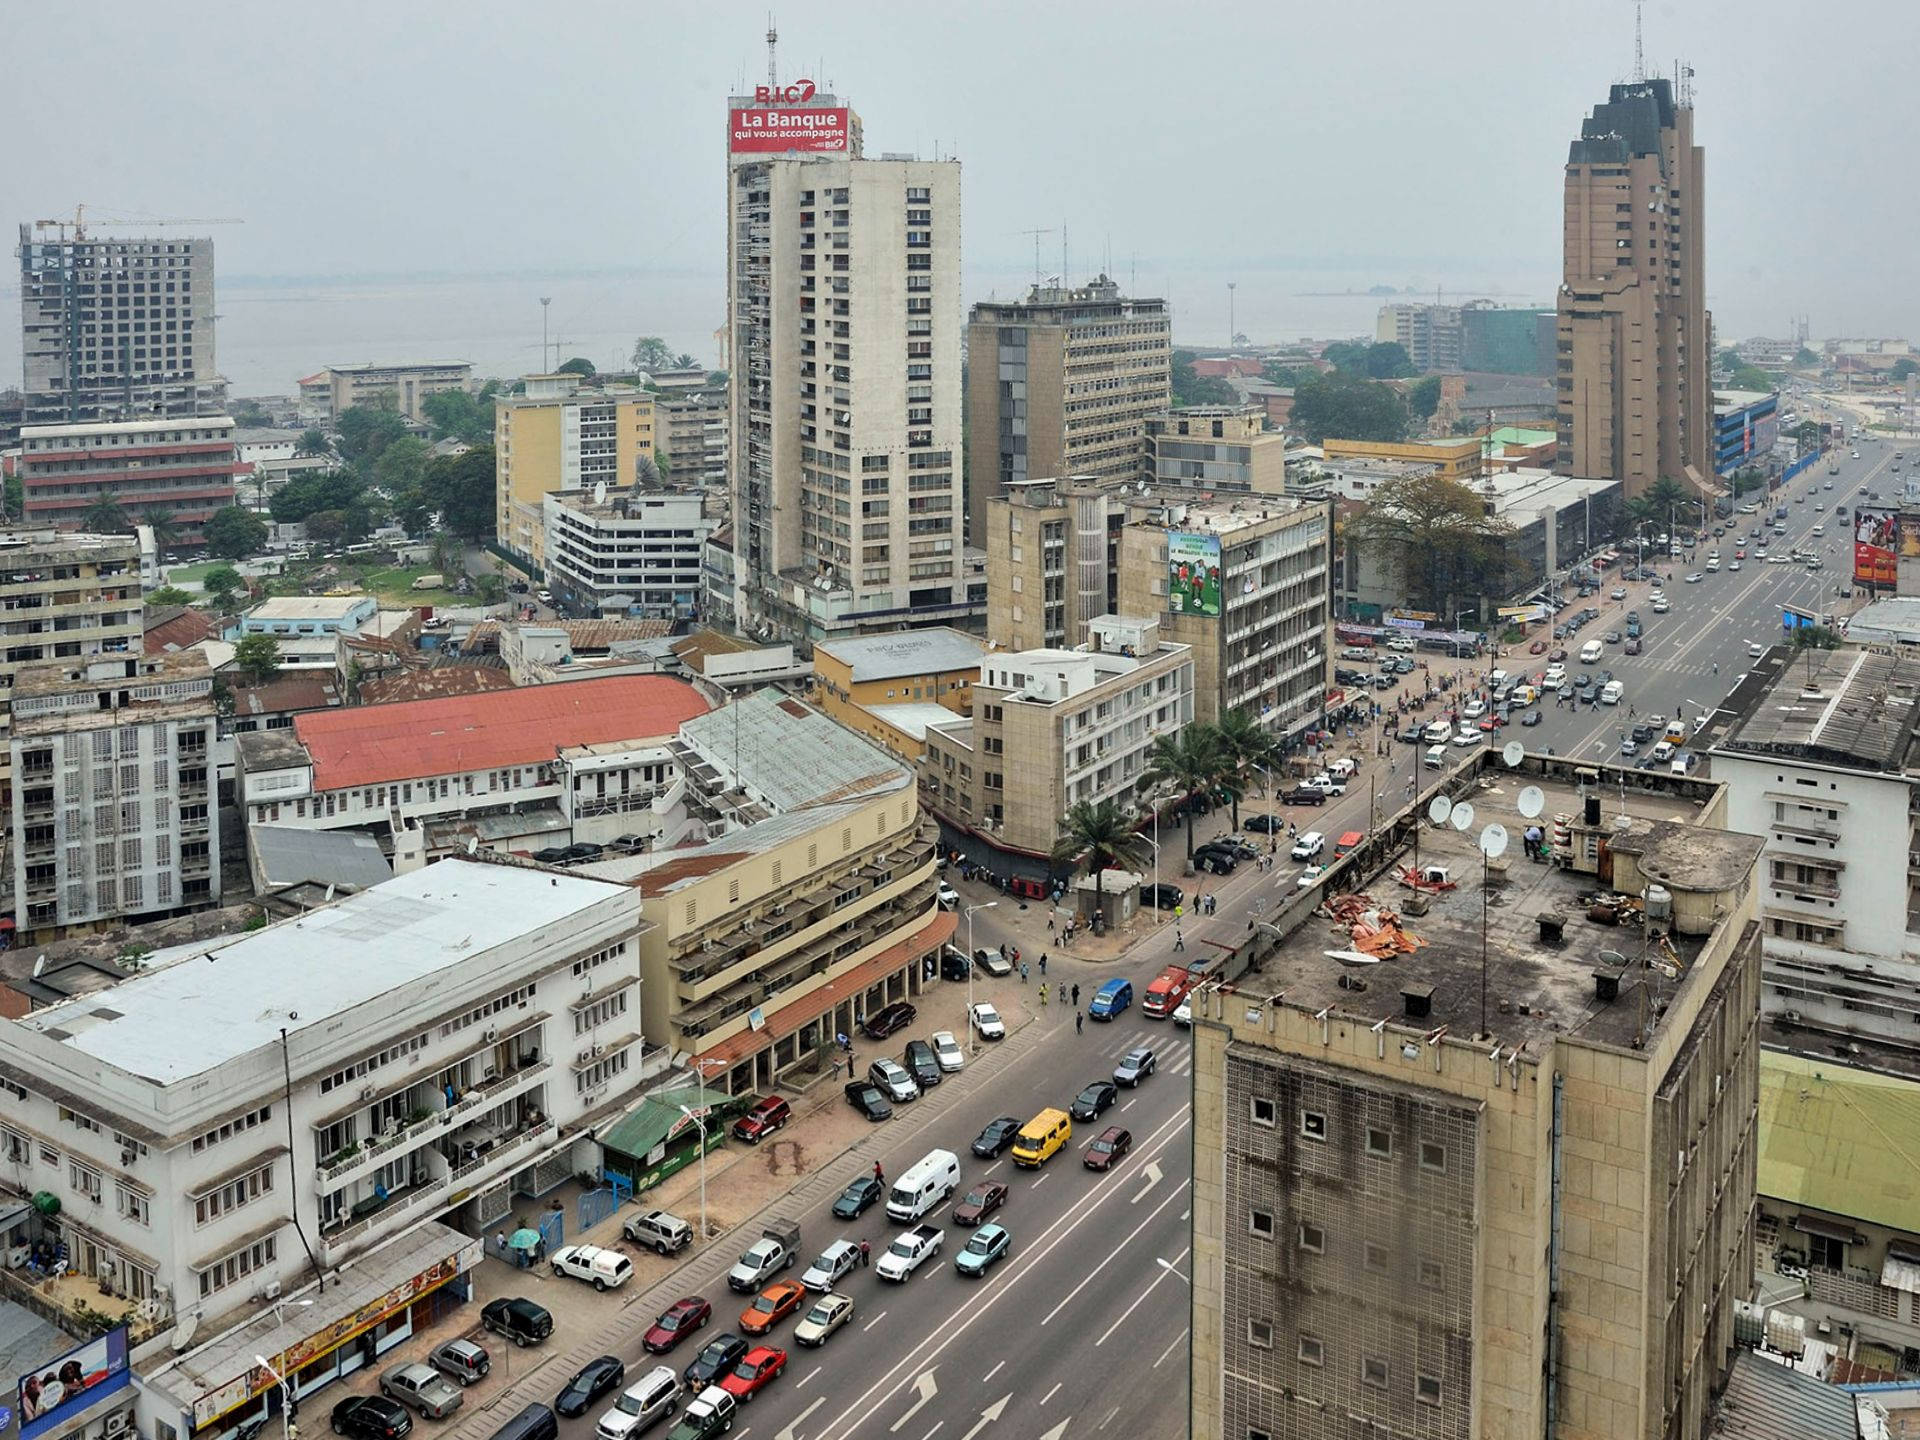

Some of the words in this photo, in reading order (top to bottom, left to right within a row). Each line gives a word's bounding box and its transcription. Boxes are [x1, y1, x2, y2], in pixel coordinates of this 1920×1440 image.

[742, 112, 762, 127] La
[767, 112, 838, 129] Banque
[735, 129, 751, 139] qui
[753, 130, 778, 138] vous
[779, 129, 844, 139] accompagne
